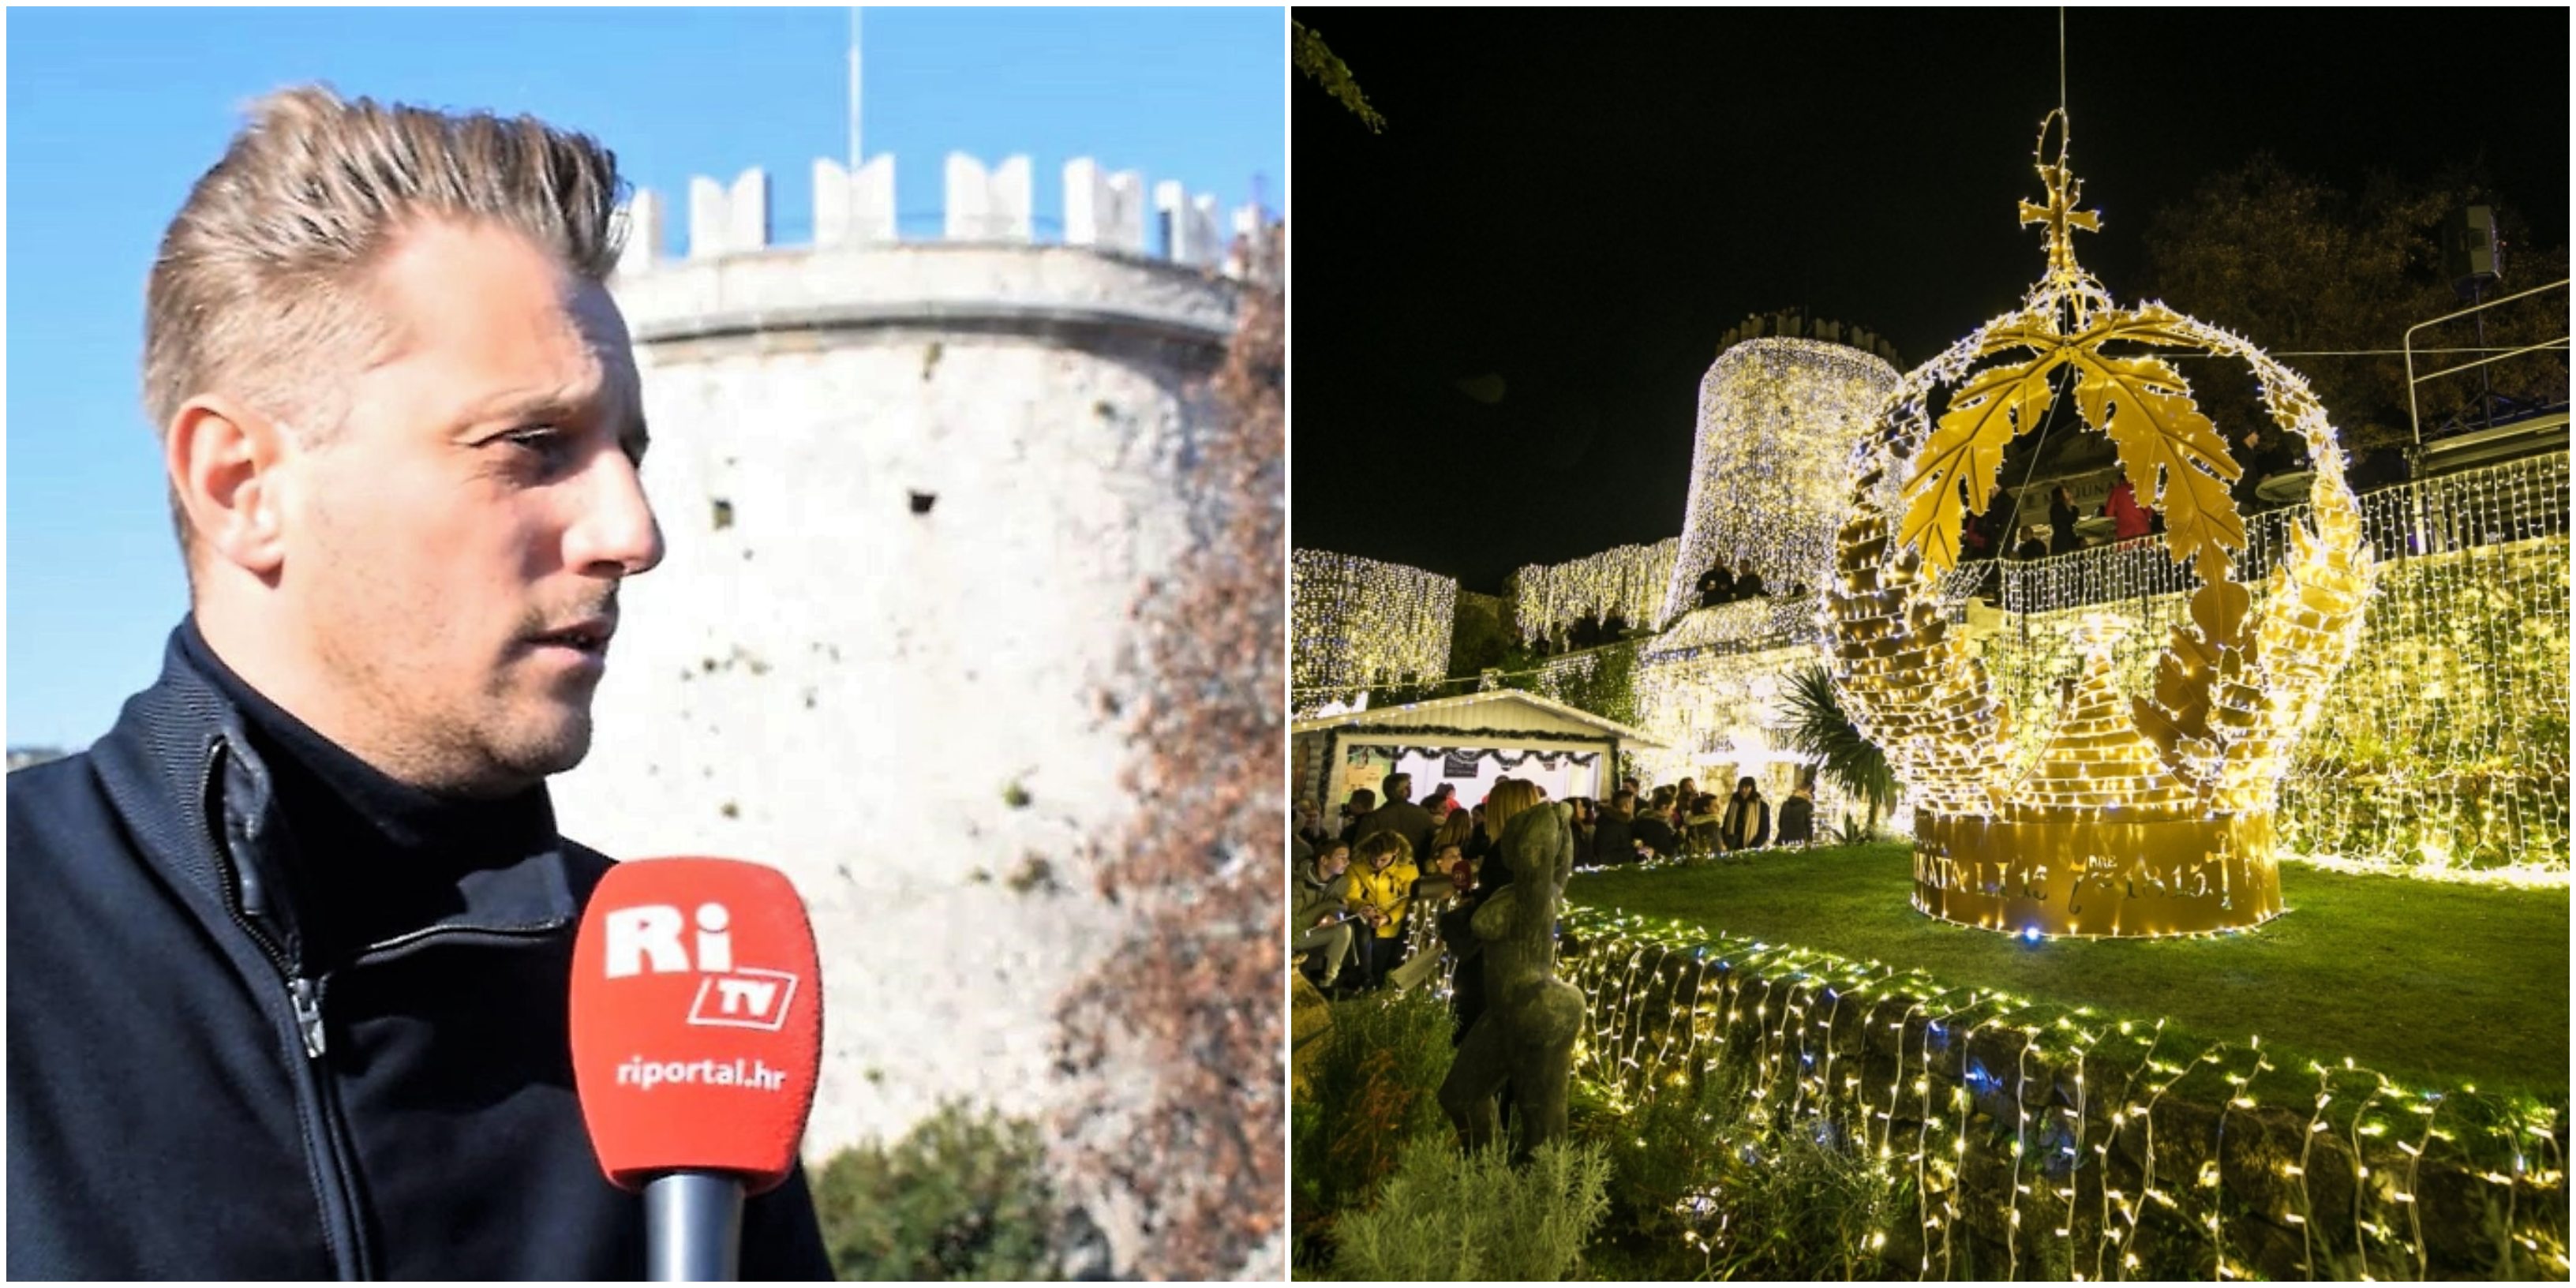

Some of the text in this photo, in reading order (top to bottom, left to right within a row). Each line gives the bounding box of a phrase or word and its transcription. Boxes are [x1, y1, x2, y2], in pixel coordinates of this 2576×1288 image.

[605, 902, 732, 979] Ri
[717, 979, 777, 1017] TV
[616, 1056, 786, 1091] riportal.hr
